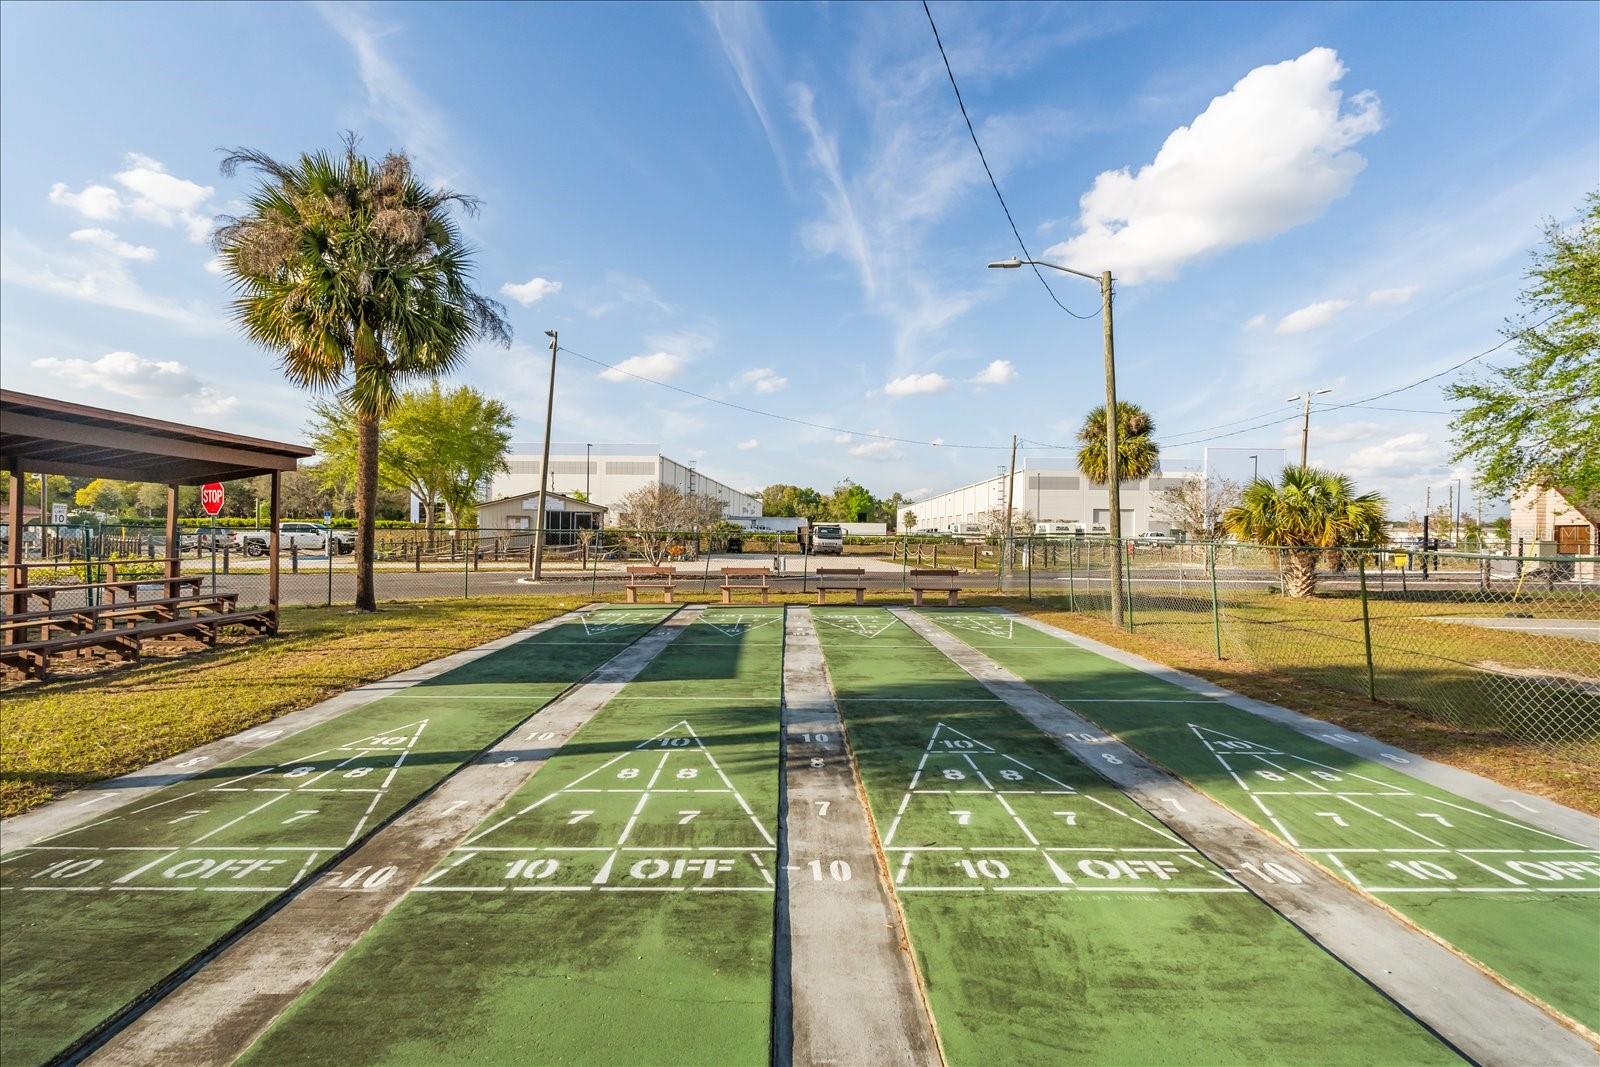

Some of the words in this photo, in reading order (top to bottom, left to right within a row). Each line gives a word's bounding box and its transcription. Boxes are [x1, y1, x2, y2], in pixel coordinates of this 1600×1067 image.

[203, 490, 222, 503] STOP
[54, 514, 65, 523] 10
[525, 732, 554, 741] 10
[658, 738, 690, 747] 10
[801, 733, 829, 743] 10
[1065, 733, 1099, 743] 10
[939, 740, 974, 749] 10
[498, 756, 518, 768] 8
[810, 757, 825, 768] 8
[1101, 753, 1124, 764] 8
[343, 767, 374, 778] 8
[617, 768, 640, 779] 8
[676, 768, 698, 779] 8
[942, 769, 966, 780] 8
[1000, 769, 1024, 781] 8
[1255, 770, 1286, 781] 8
[1311, 770, 1343, 782] 8
[815, 801, 830, 816] 7
[1160, 798, 1187, 812] 7
[567, 811, 594, 825] 7
[679, 811, 700, 825] 7
[950, 811, 971, 825] 7
[1053, 811, 1077, 825] 7
[1314, 812, 1350, 827] 7
[1415, 812, 1454, 827] 7
[30, 858, 104, 879] 10
[162, 858, 288, 879] OFF
[505, 859, 559, 879] 10
[629, 859, 735, 879] OFF
[954, 859, 1010, 879] 10
[1077, 859, 1179, 880] OFF
[1387, 860, 1457, 880] 10
